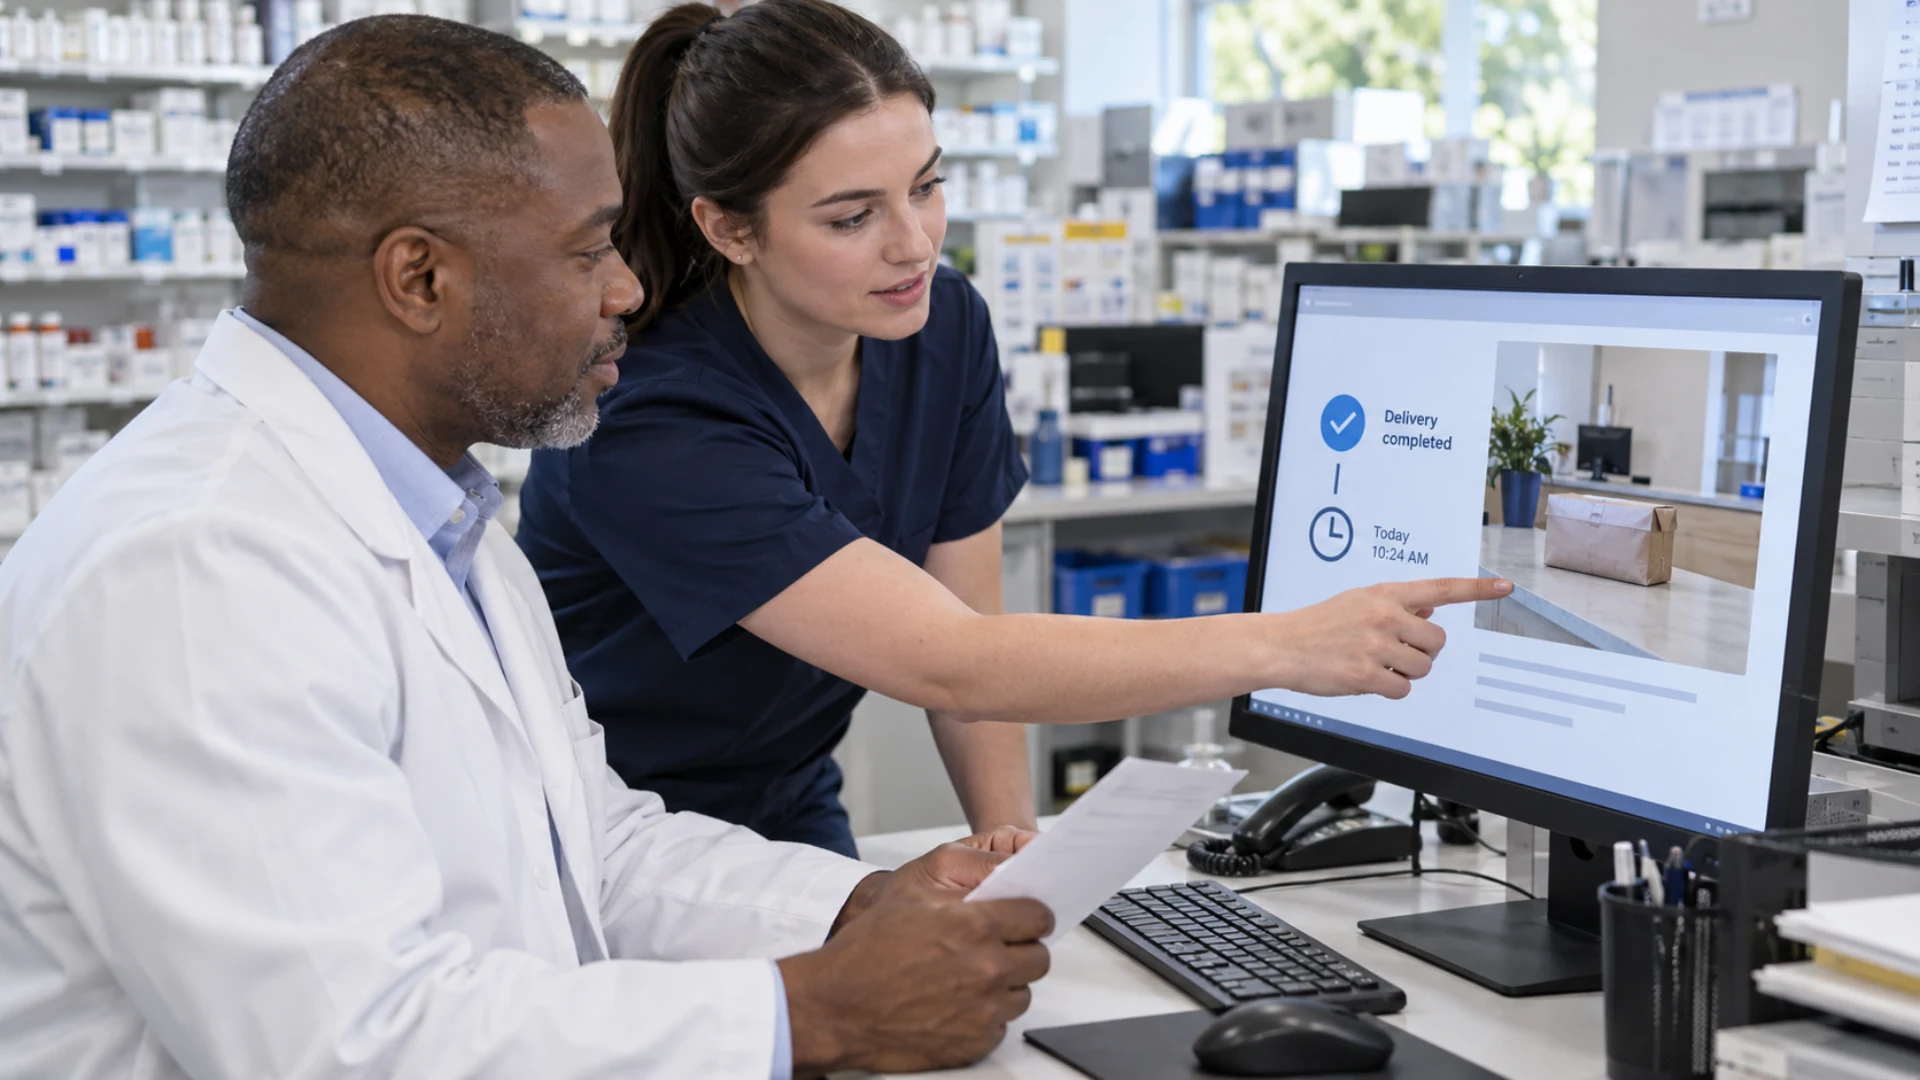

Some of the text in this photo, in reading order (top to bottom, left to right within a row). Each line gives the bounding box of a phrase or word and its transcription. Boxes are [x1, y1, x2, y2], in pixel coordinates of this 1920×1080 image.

[1384, 409, 1438, 430] Delivery
[1382, 433, 1452, 451] completed
[1374, 525, 1409, 545] Today
[1372, 545, 1429, 566] 10:24 AM
